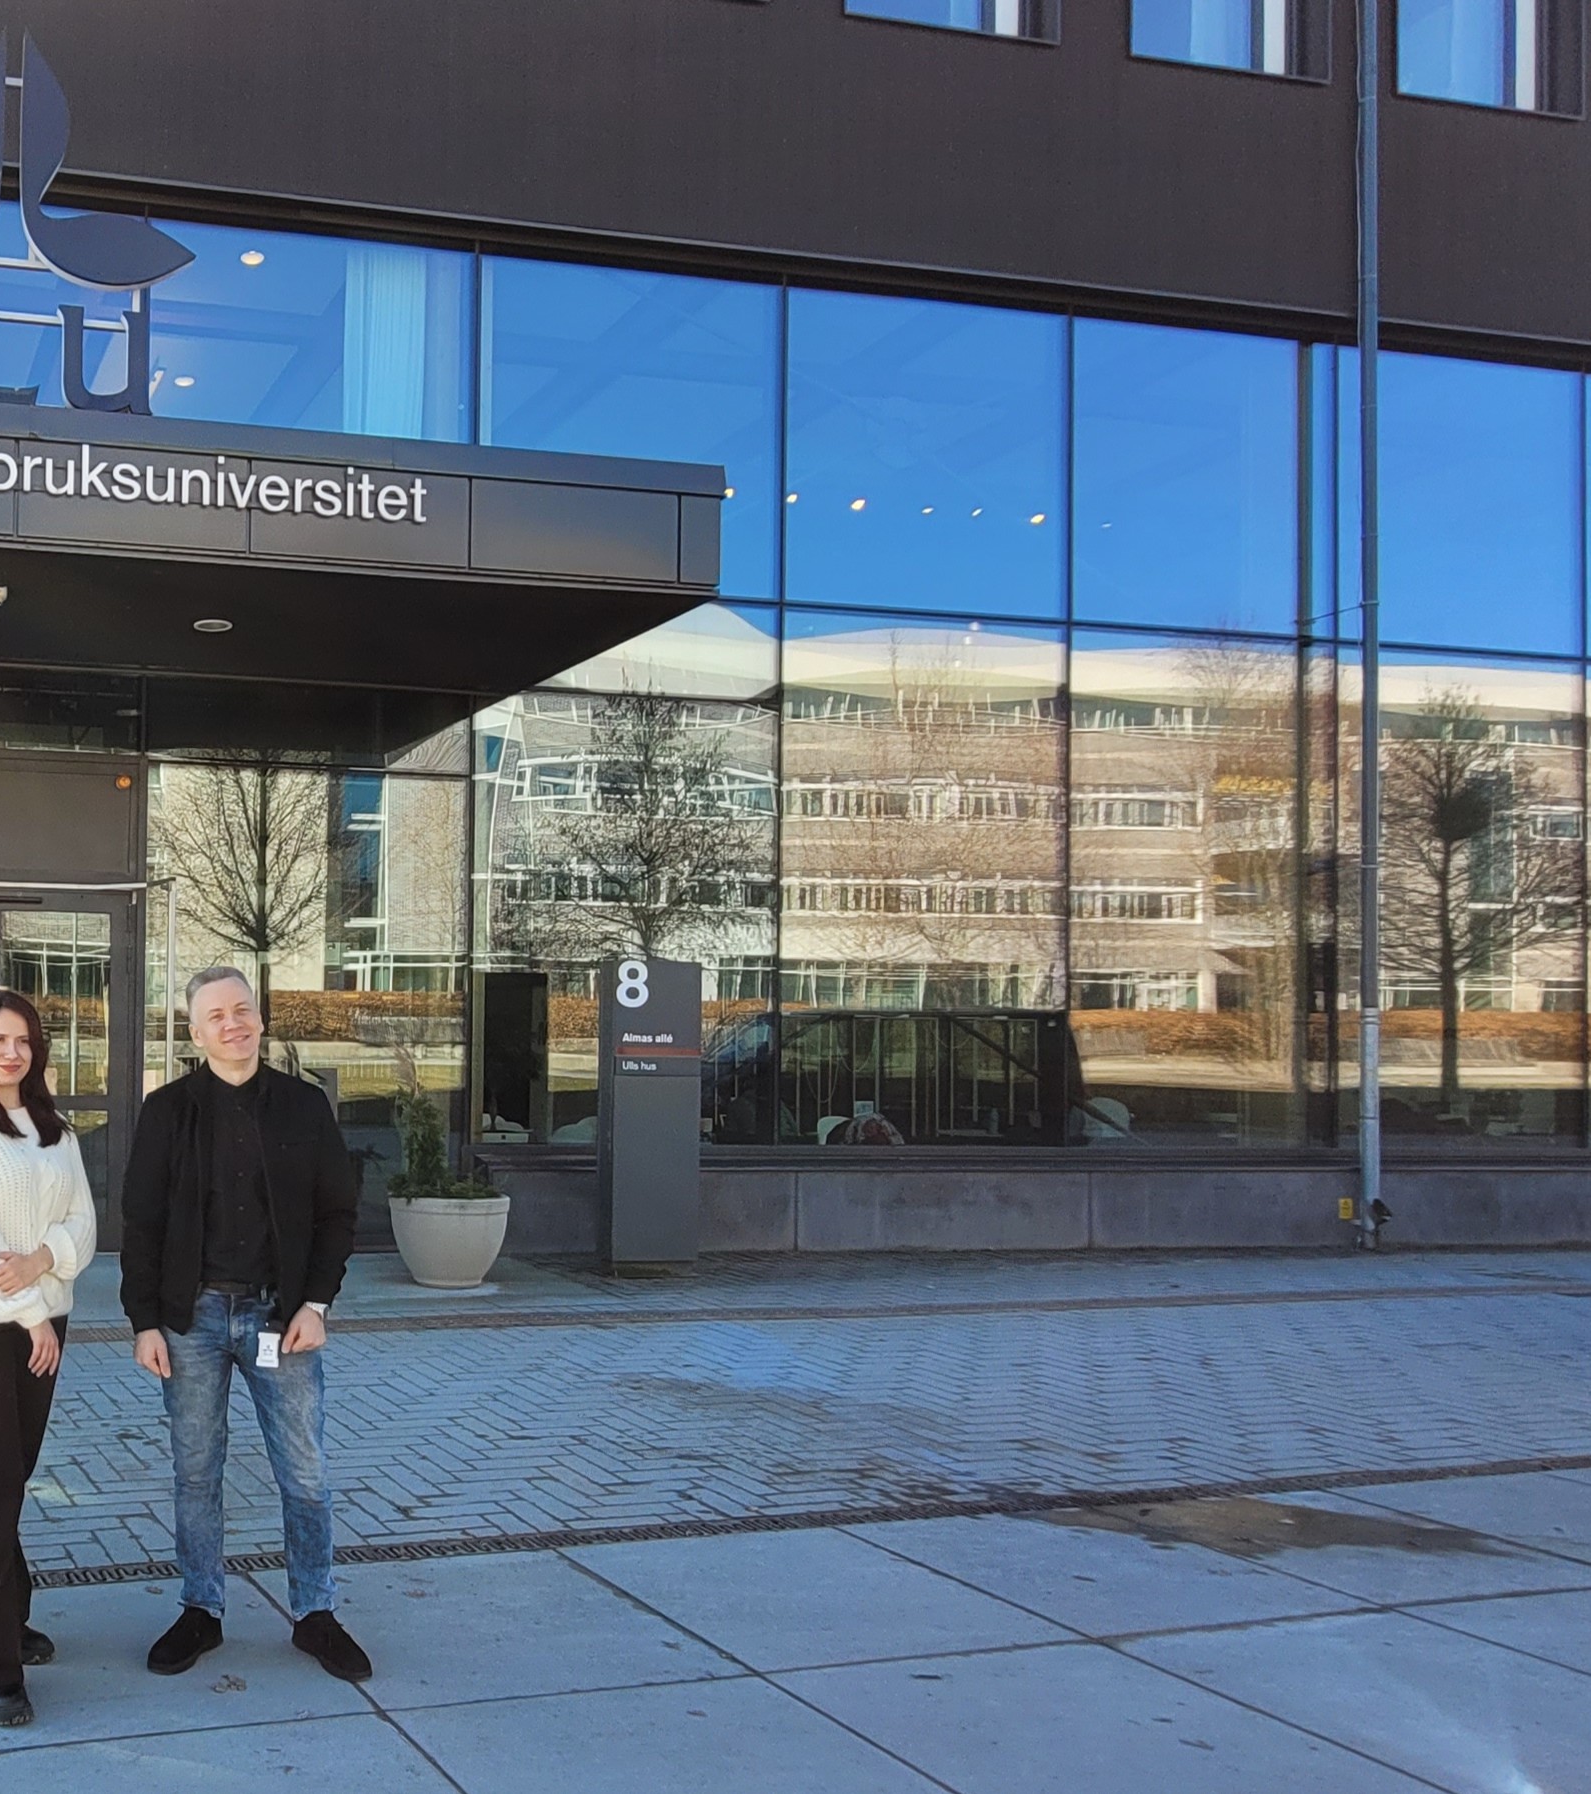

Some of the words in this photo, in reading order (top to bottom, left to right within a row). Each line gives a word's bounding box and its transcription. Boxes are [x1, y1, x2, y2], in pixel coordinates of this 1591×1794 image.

[615, 960, 650, 1009] 8
[622, 1032, 653, 1043] Almas
[622, 1060, 639, 1071] Ulls
[640, 1060, 657, 1071] hus
